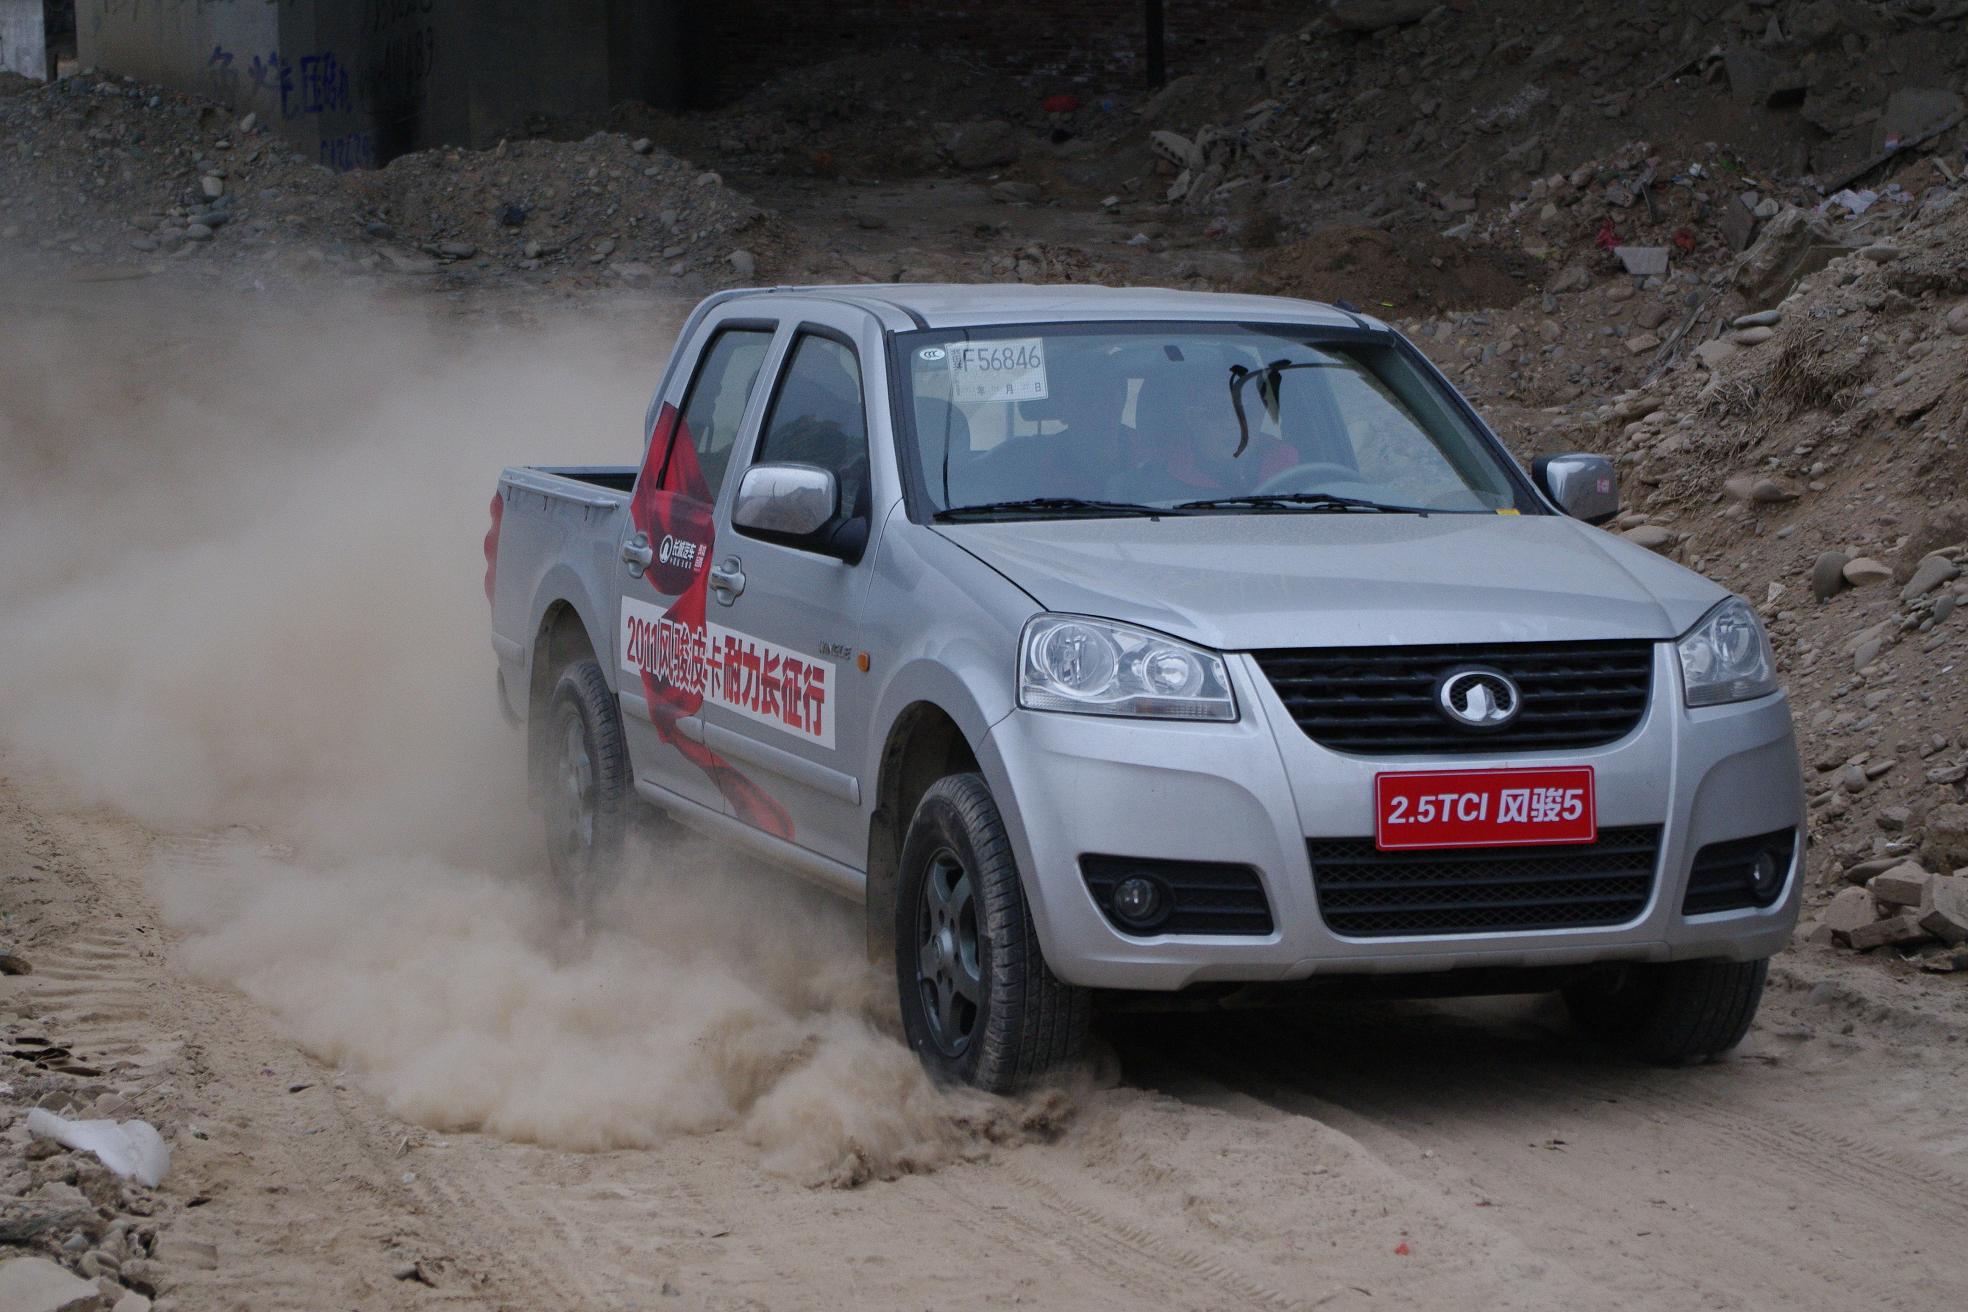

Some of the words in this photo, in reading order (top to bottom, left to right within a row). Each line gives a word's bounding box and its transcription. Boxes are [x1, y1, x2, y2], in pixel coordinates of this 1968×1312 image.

[962, 345, 1041, 372] F56846
[1387, 792, 1489, 825] 2.5TCI
[1496, 787, 1584, 824] 风骏5
